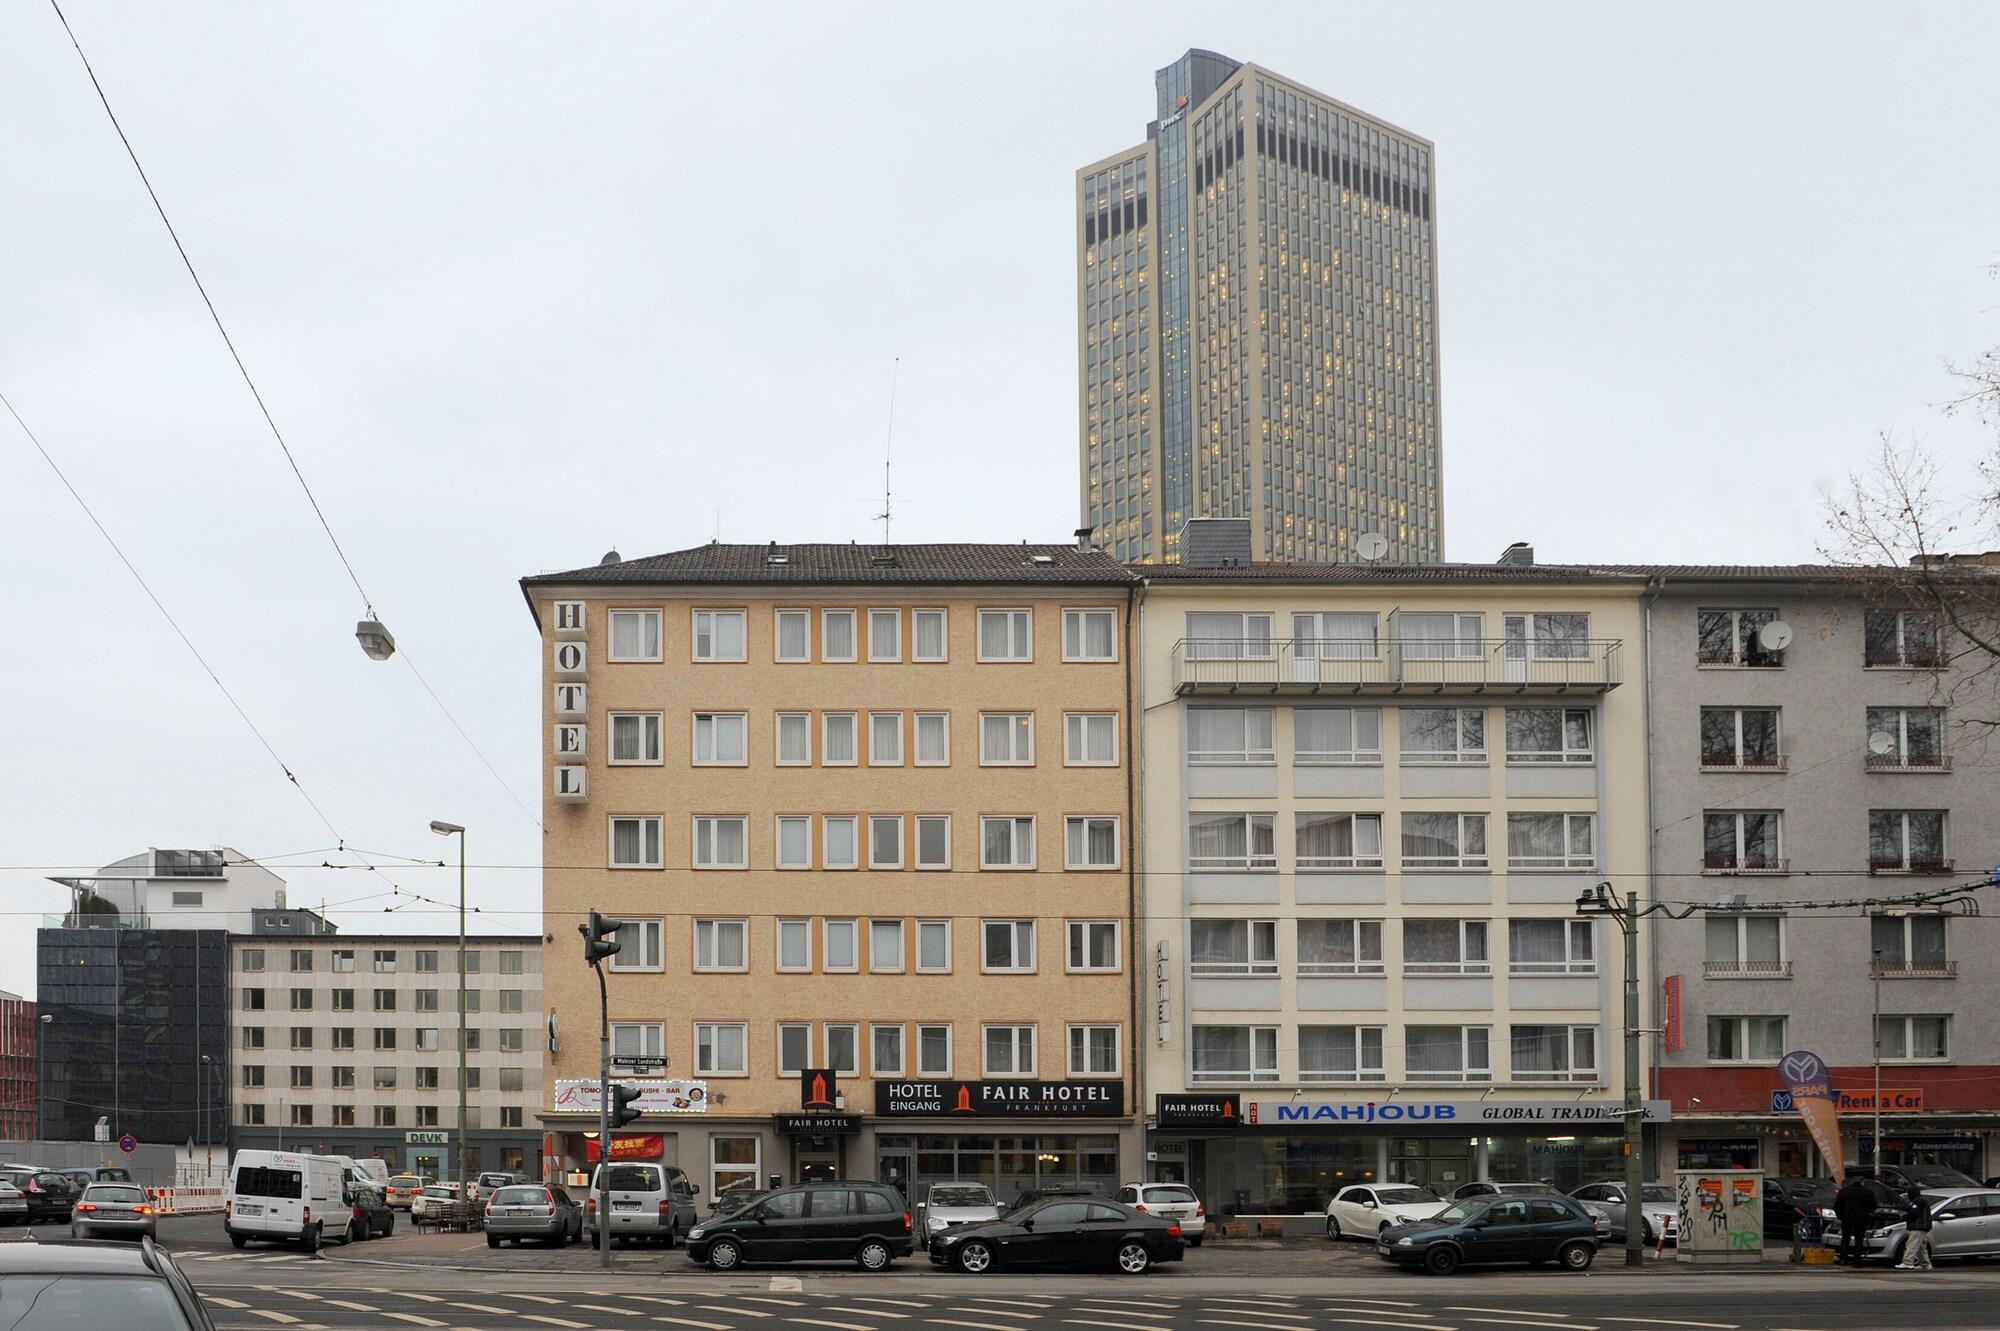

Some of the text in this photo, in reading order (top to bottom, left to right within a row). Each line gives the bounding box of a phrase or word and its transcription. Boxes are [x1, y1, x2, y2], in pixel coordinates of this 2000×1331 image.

[557, 604, 582, 793] HOTEL
[889, 1084, 942, 1098] HOTEL
[983, 1087, 1110, 1100] FAIR HOTEL
[890, 1101, 941, 1111] EINGANG
[1895, 1094, 1921, 1108] Car
[1165, 1104, 1221, 1112] FAIR HOTEL
[1483, 1107, 1545, 1119] GLOBAL
[789, 1119, 848, 1127] FAIR HOTEL
[411, 1133, 442, 1143] DEVK
